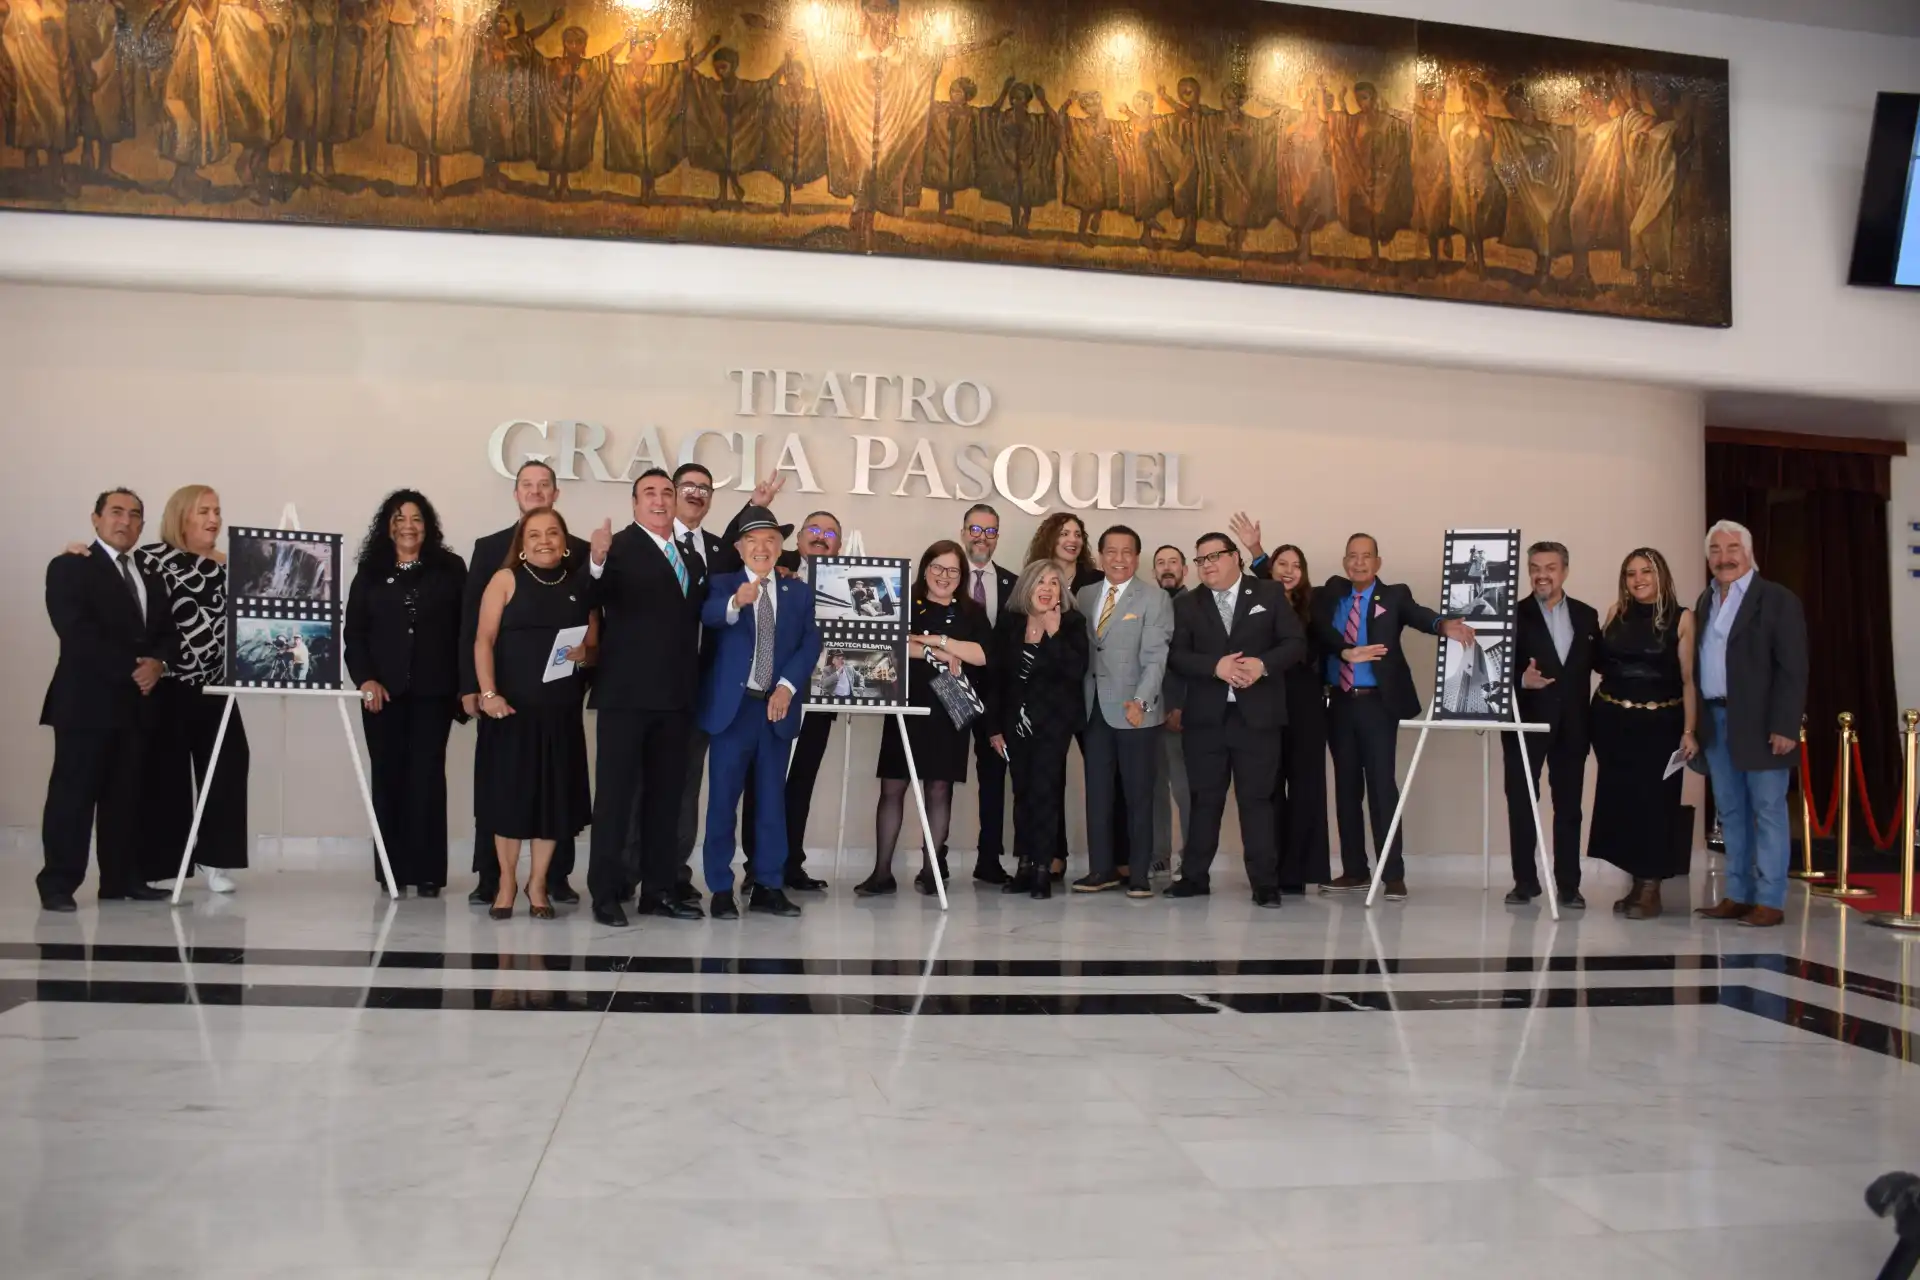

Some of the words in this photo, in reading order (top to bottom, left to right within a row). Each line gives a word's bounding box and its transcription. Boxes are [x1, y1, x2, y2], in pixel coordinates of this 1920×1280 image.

[726, 368, 992, 427] TEATRO
[488, 419, 826, 494] GRACIA
[846, 434, 1204, 516] PASQUEL
[825, 640, 861, 649] FILMOTECA
